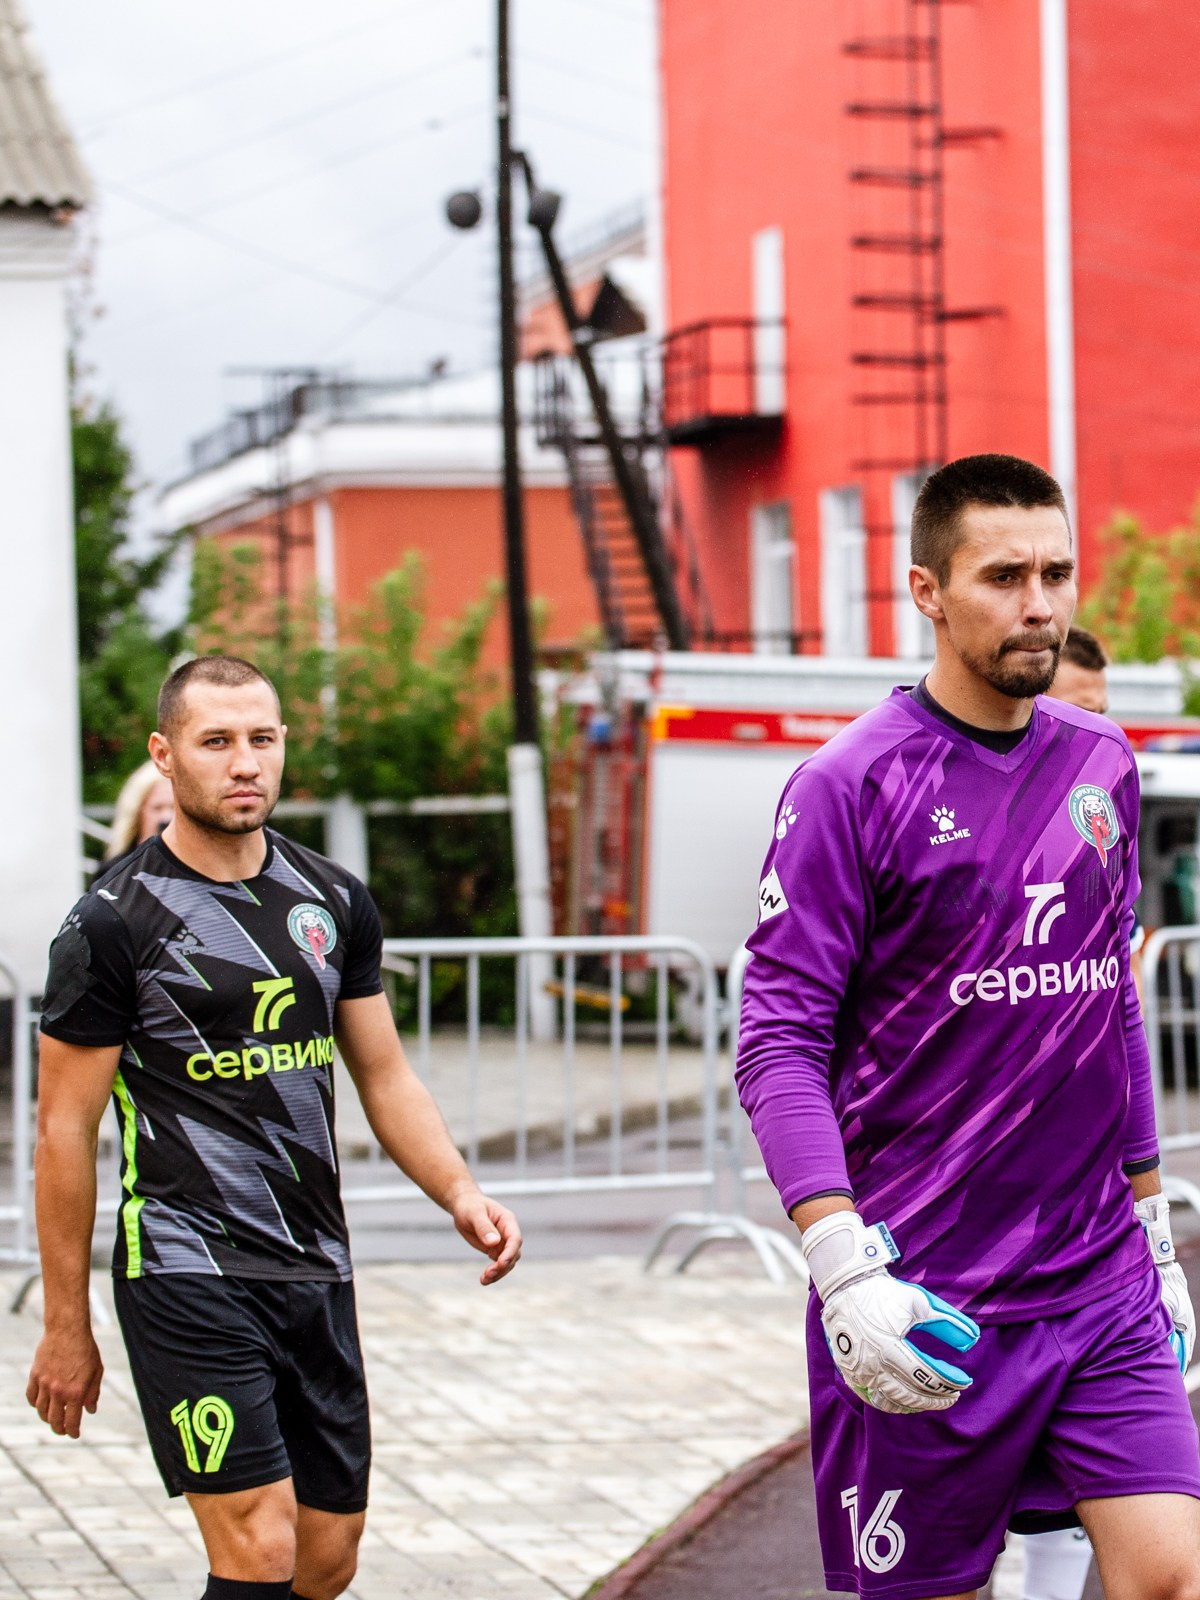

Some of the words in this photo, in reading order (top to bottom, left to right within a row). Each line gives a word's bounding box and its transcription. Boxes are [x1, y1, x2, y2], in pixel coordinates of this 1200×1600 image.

[1074, 787, 1105, 800] ИРКУТСК
[930, 828, 971, 846] KELME
[949, 955, 1119, 1006] сервико
[186, 1035, 335, 1082] сервико
[878, 1224, 898, 1257] ELITE
[171, 1396, 235, 1473] 19
[840, 1485, 906, 1574] 16
